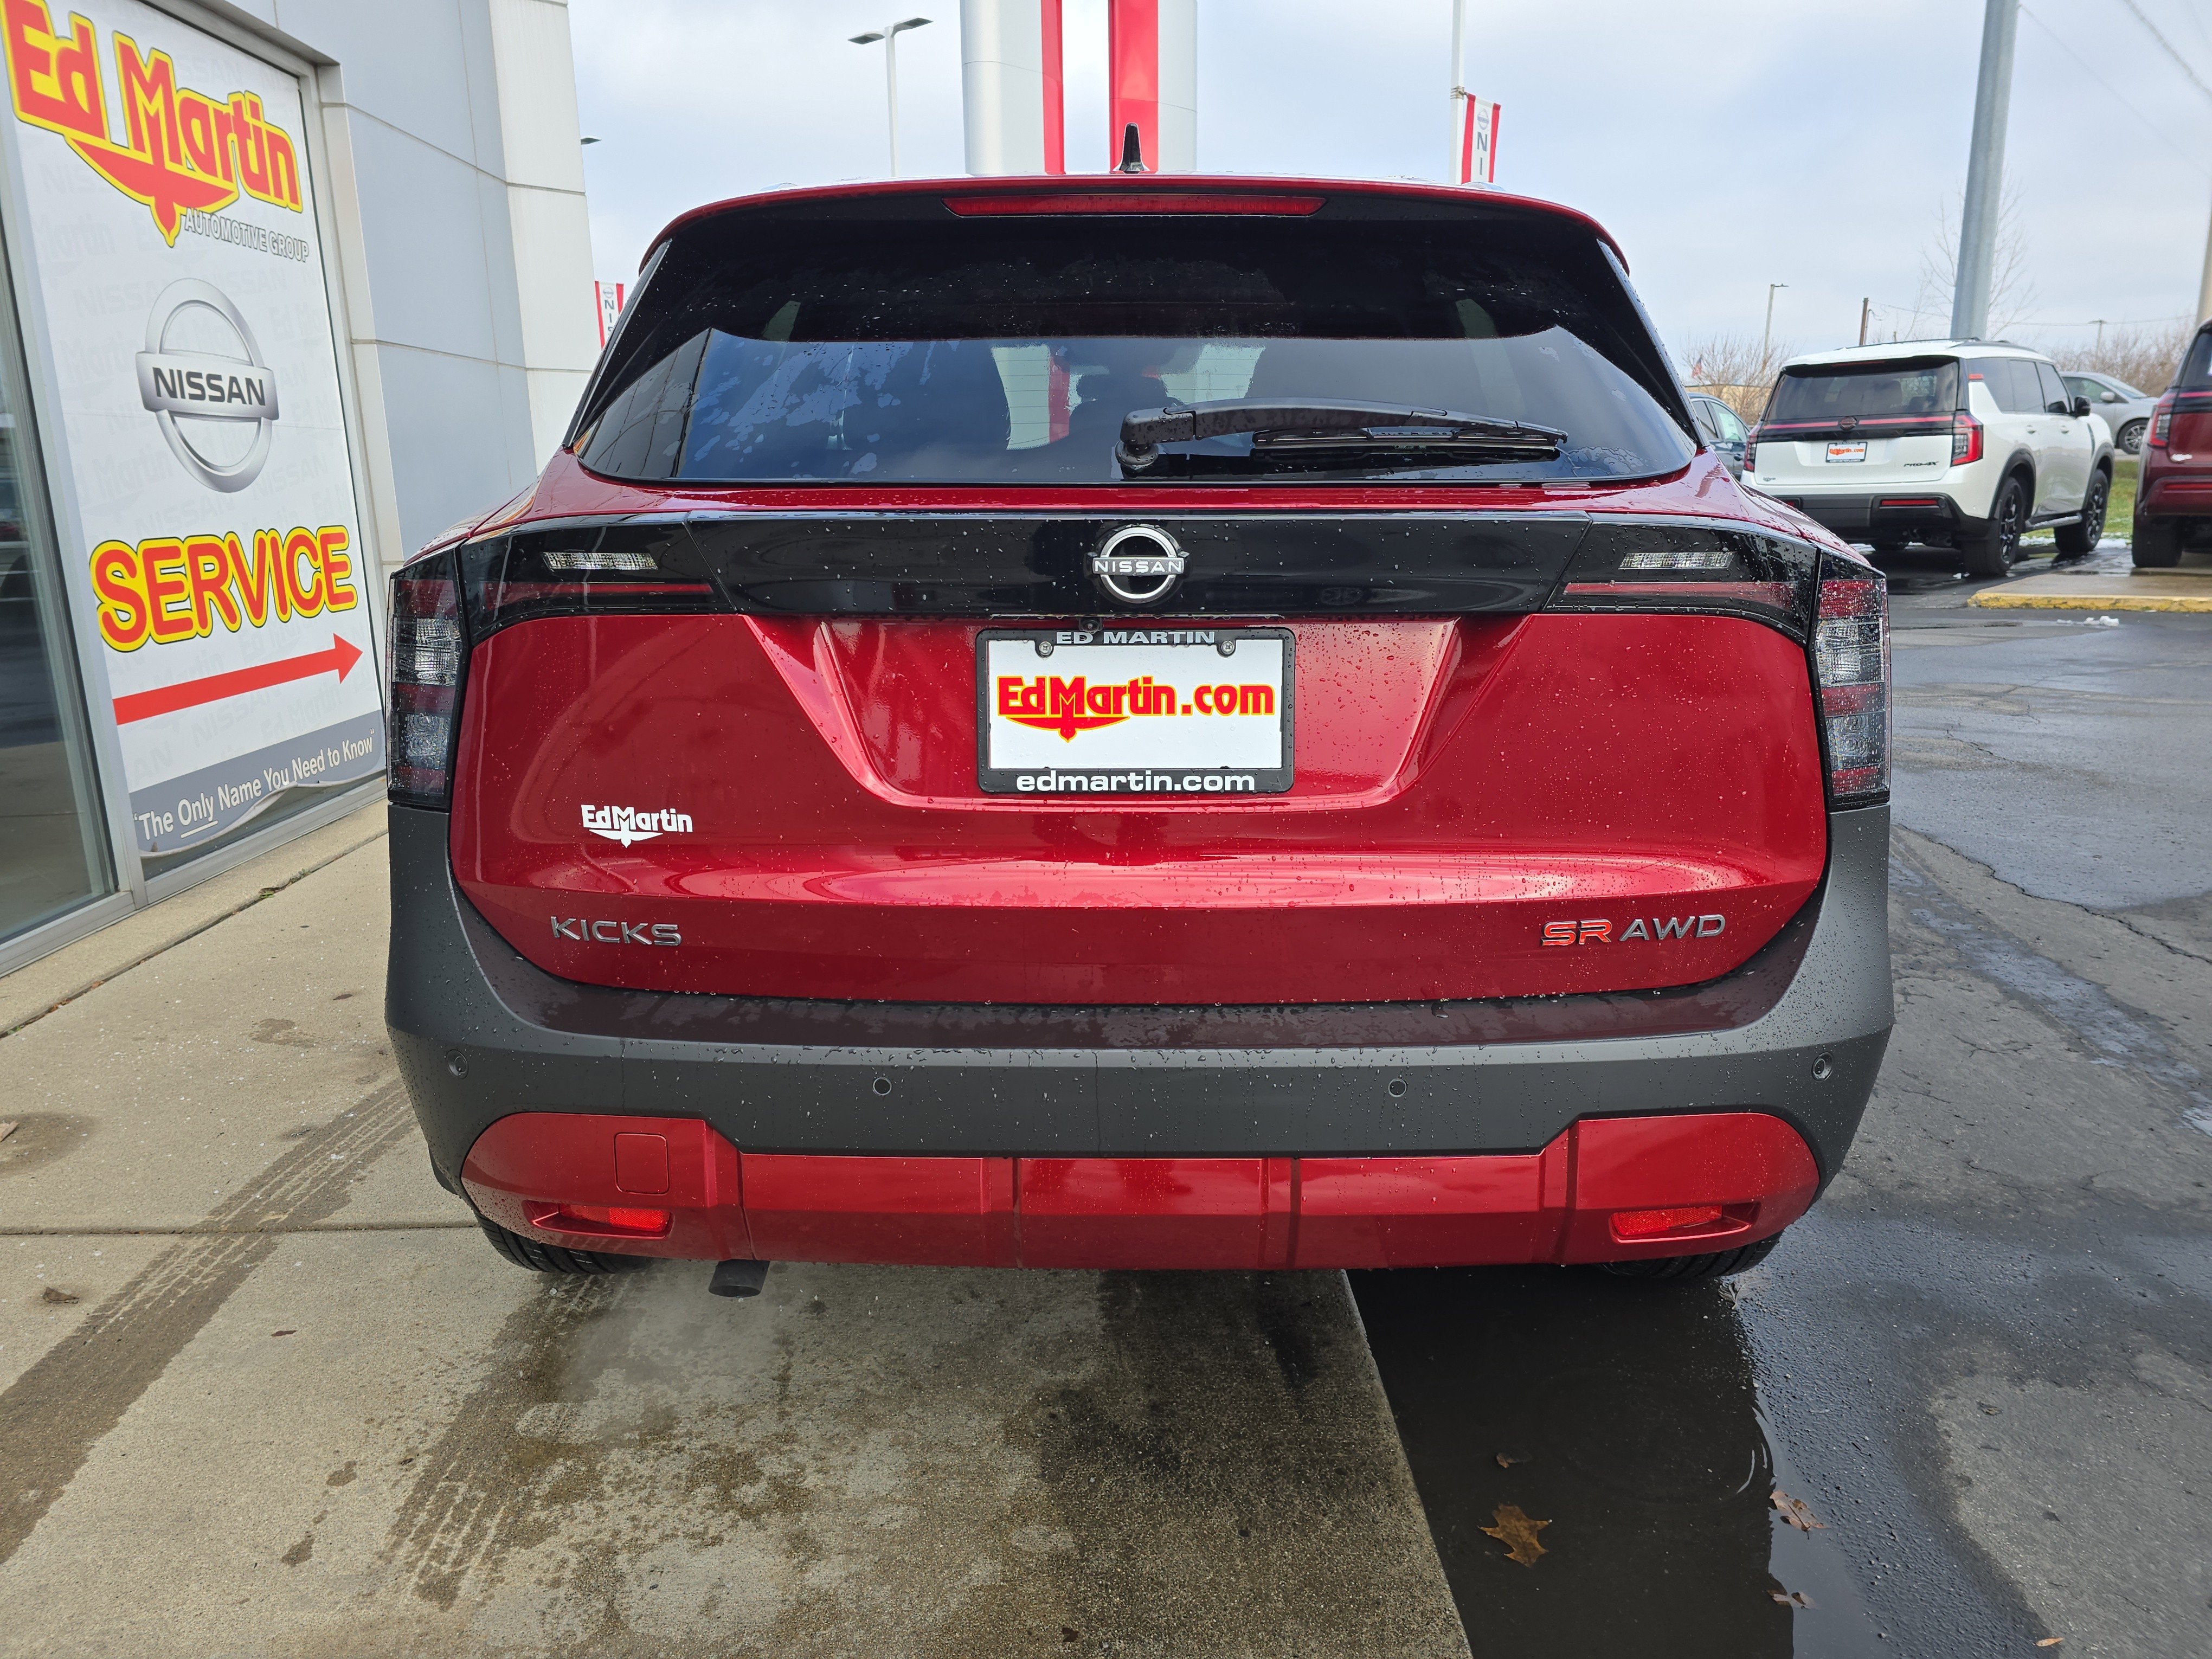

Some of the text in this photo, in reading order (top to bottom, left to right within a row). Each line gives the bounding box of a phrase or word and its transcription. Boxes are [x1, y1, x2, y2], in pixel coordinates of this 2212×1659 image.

[2, 0, 303, 213] Ed Martin
[184, 207, 268, 253] AUTOMOTIVE
[269, 230, 310, 263] GROUP
[152, 367, 266, 407] NISSAN
[1094, 560, 1182, 573] NISSAN
[91, 526, 357, 649] SERVICE
[1056, 631, 1215, 645] ED MARTIN
[177, 792, 214, 827] Only
[217, 779, 262, 812] Name
[263, 767, 290, 792] You
[291, 748, 326, 783] Need
[327, 747, 340, 768] to
[1016, 770, 1255, 792] edmartin.com
[550, 916, 683, 946] KICKS
[1540, 914, 1726, 947] SR AWD
